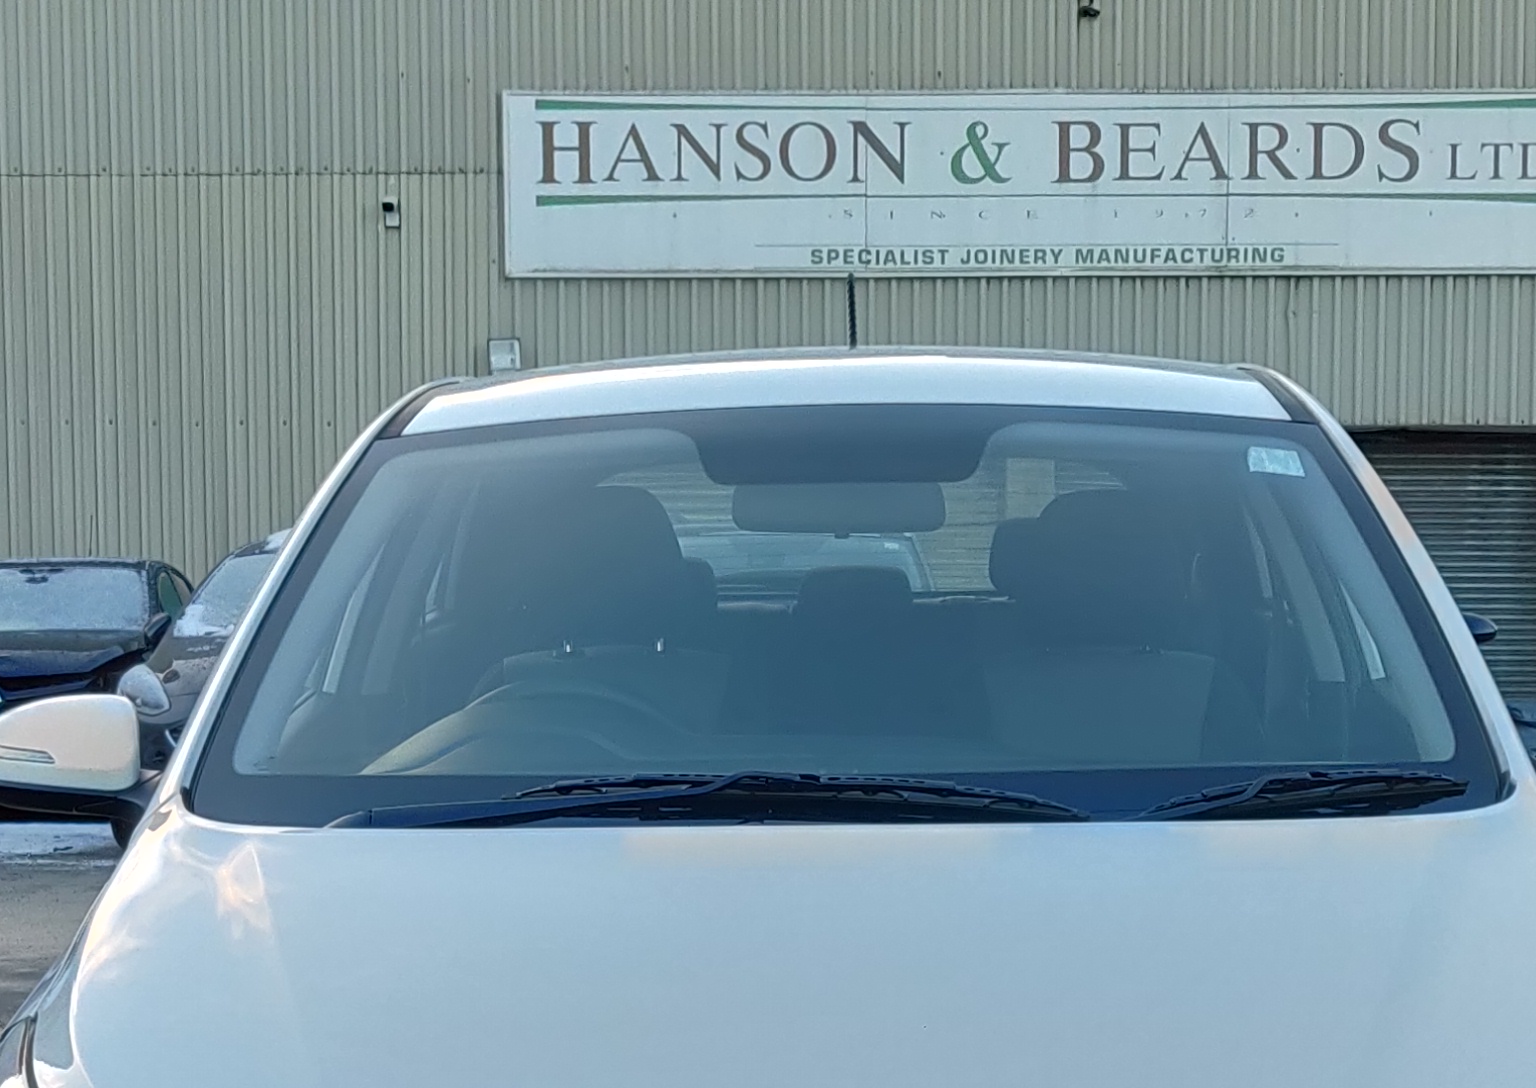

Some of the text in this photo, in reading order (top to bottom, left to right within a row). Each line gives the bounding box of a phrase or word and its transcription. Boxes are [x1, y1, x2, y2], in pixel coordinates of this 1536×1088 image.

[535, 120, 912, 185] HANSON
[949, 120, 1013, 185] &
[1050, 117, 1421, 183] BEARDS
[810, 246, 1286, 266] SPECIALIST JOINERY MANUFACTURING
